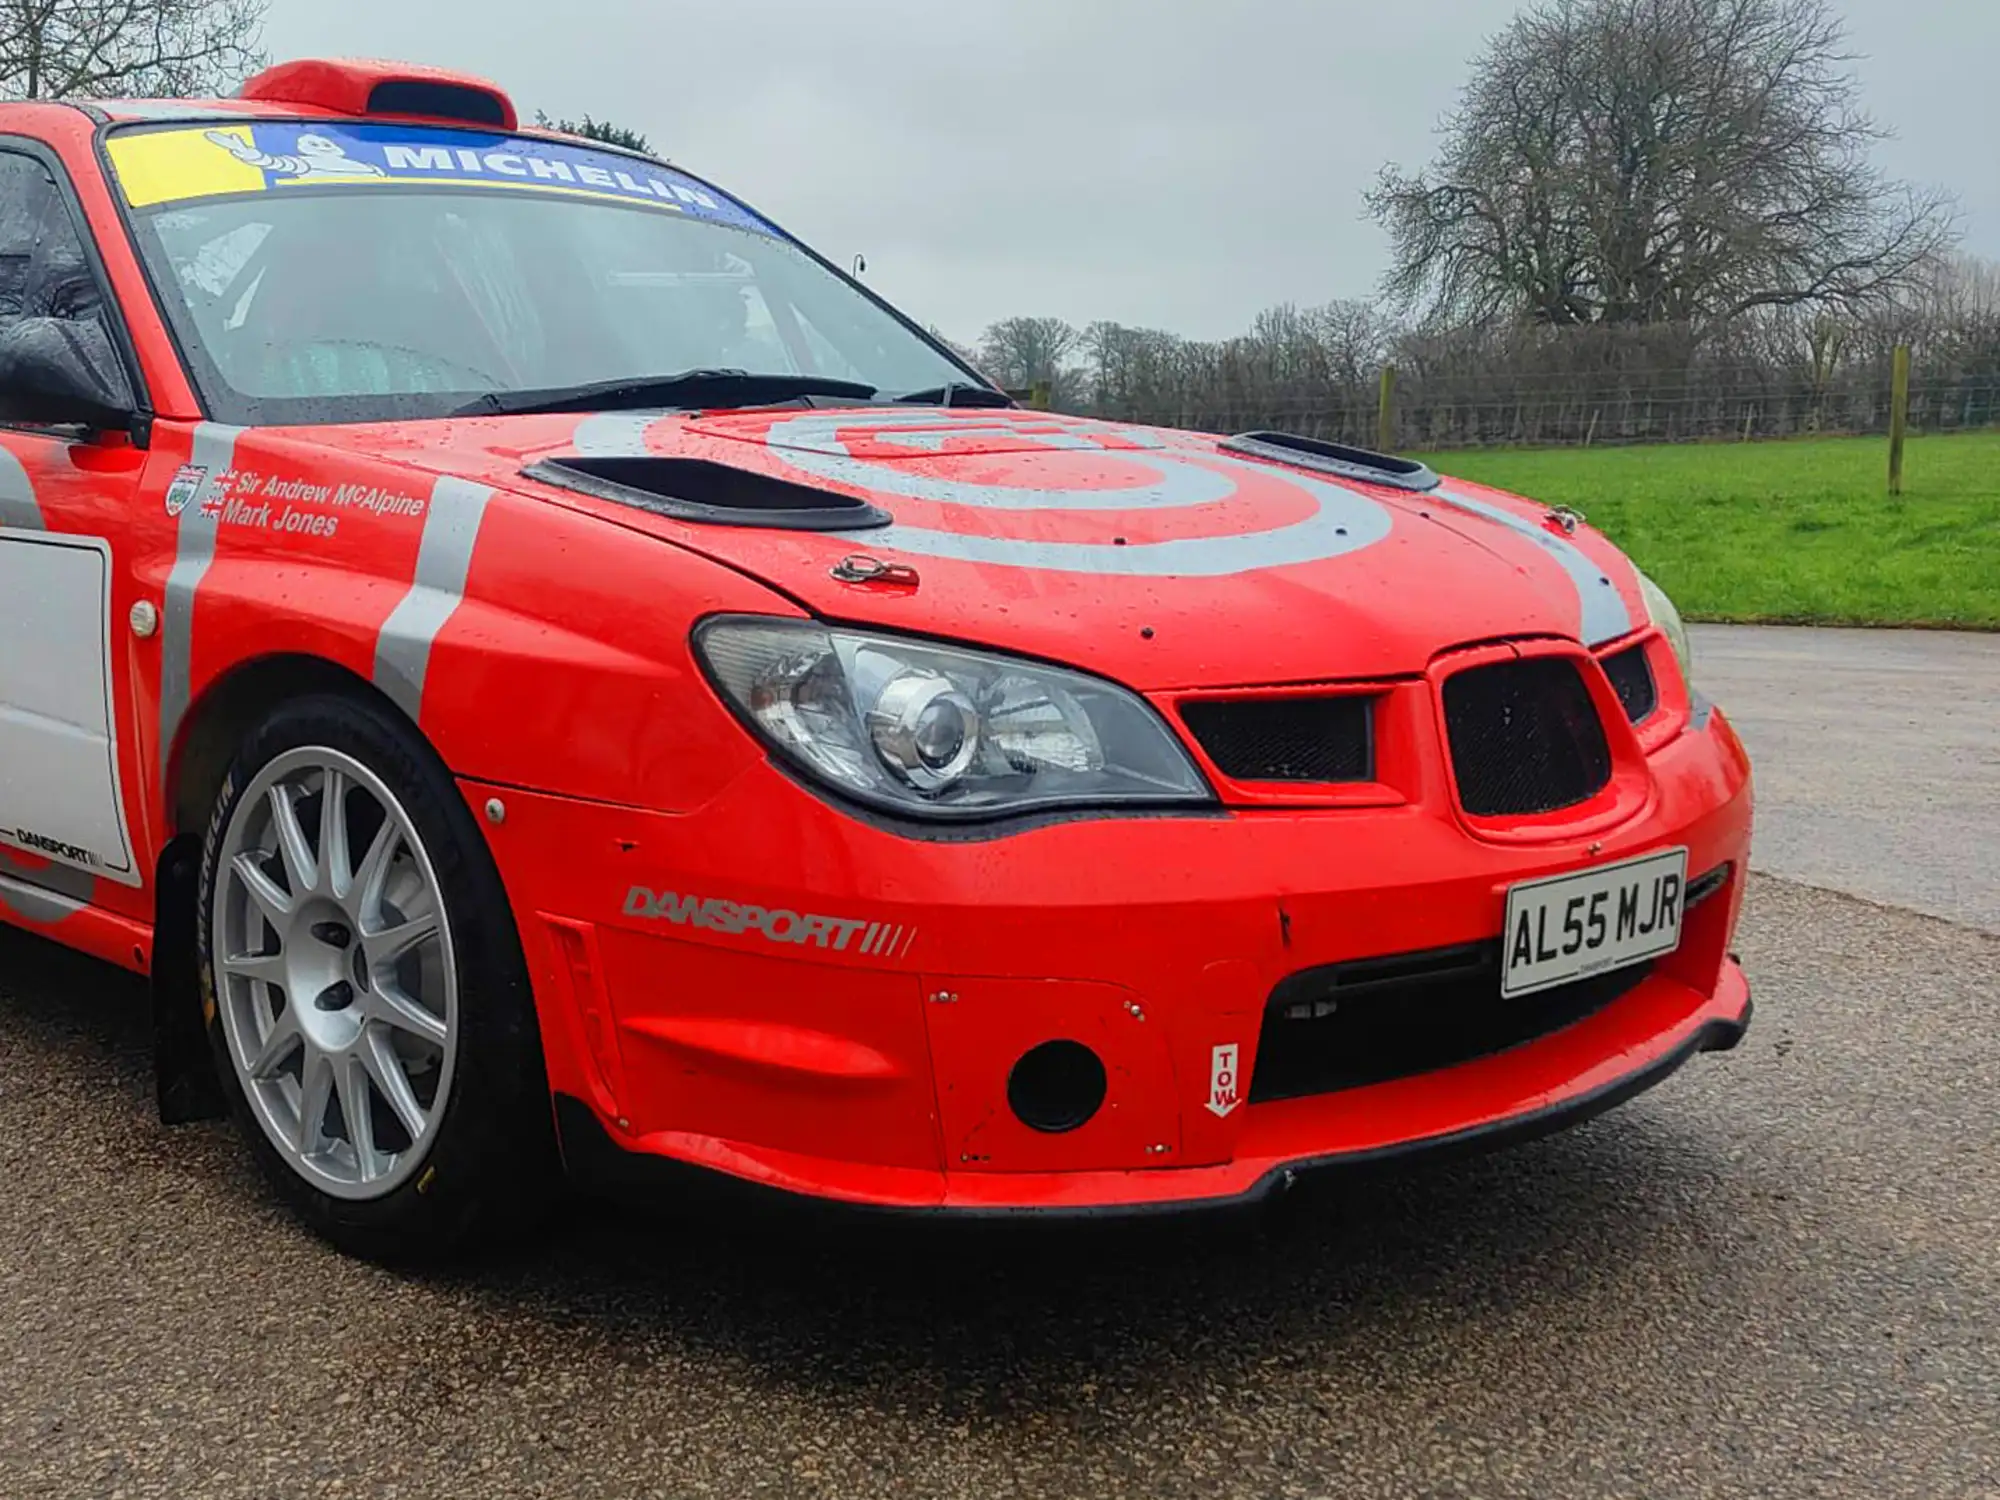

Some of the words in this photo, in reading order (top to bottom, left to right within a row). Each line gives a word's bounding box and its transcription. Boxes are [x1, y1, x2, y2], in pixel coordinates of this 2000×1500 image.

[383, 146, 718, 209] MICHELIN
[235, 471, 262, 494] Sir
[260, 474, 332, 505] Andrew
[224, 498, 273, 528] Mark
[272, 504, 338, 537] Jones
[16, 827, 90, 865] DANSPORT
[622, 885, 866, 951] DANSPORT
[1510, 890, 1609, 969] AL55
[1616, 873, 1680, 942] MJR
[1214, 1051, 1236, 1109] TOW
